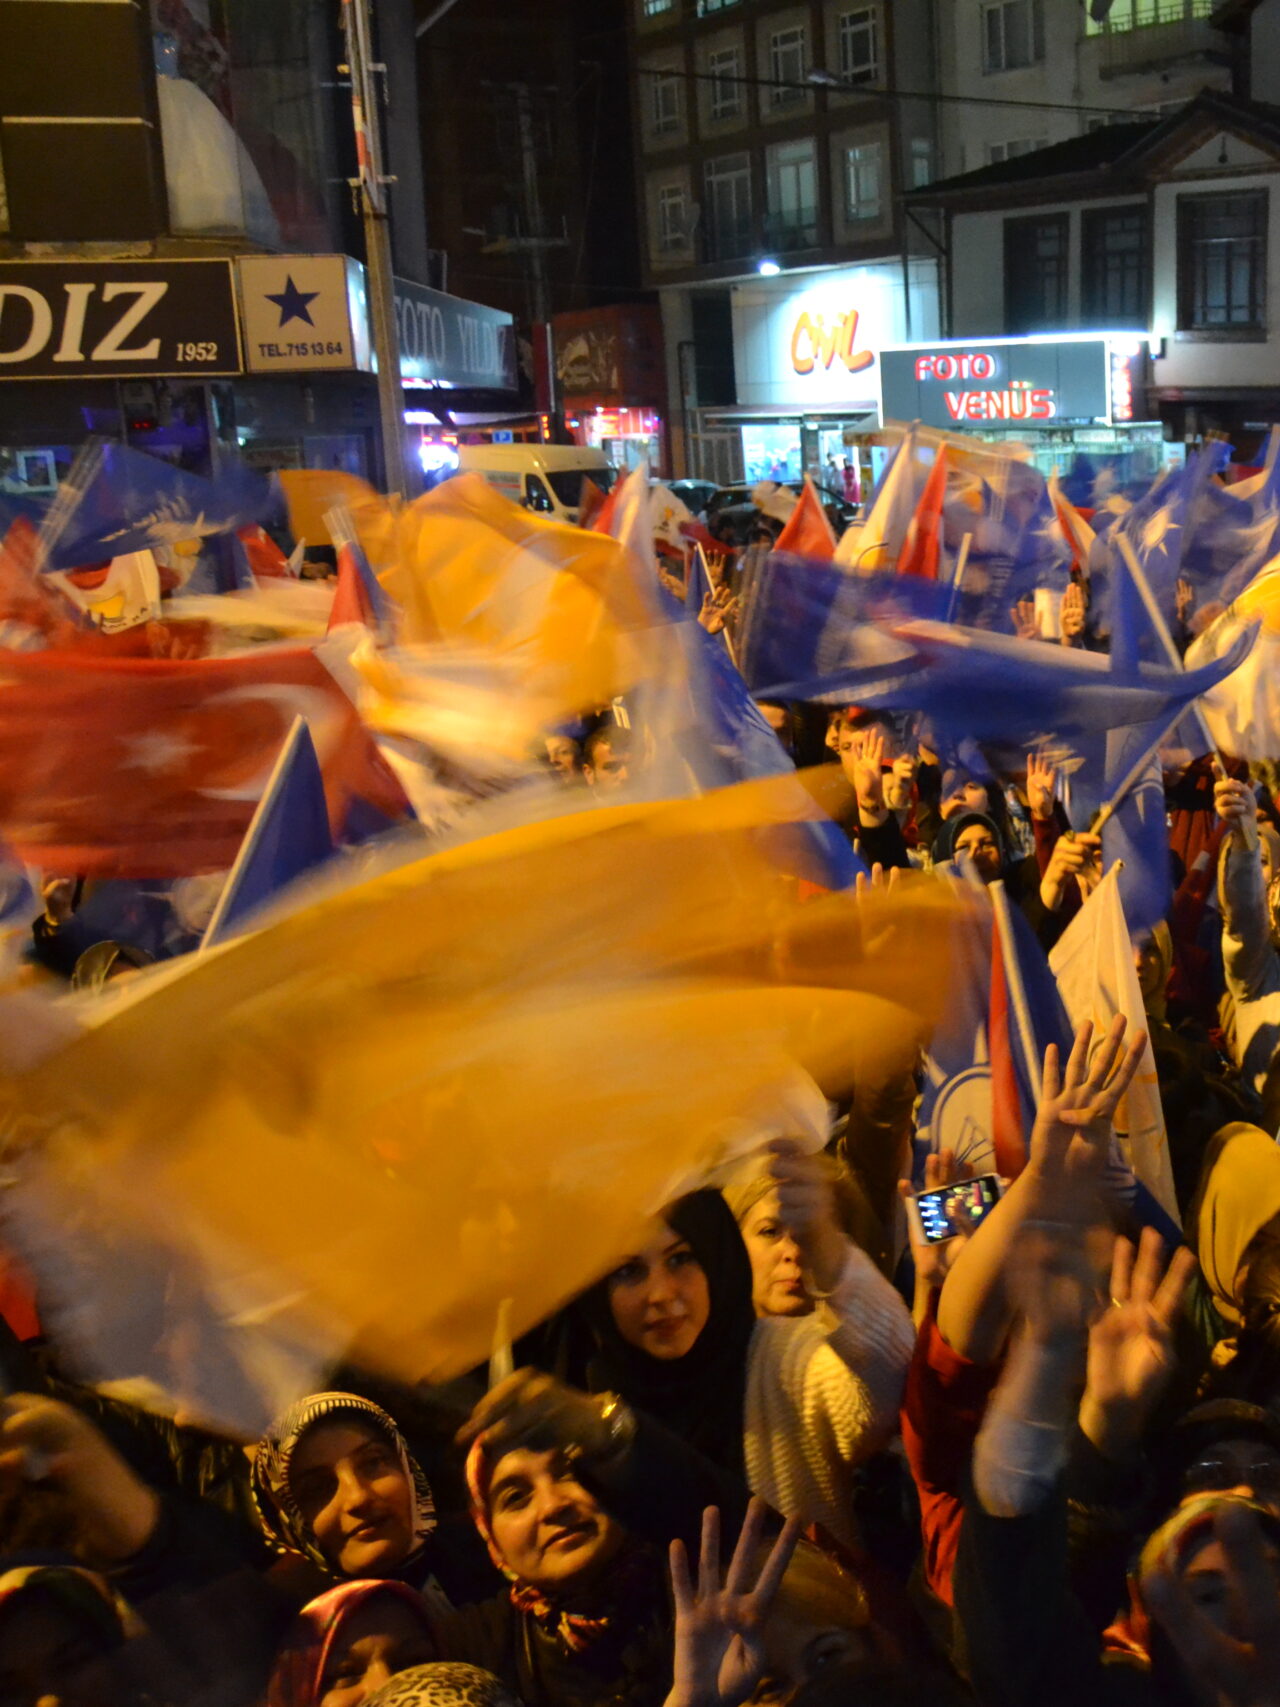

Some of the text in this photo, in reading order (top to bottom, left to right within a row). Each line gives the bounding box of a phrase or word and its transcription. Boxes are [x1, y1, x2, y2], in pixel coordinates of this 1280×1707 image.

[176, 342, 218, 362] 1952
[311, 342, 324, 356] 13
[326, 341, 343, 355] 64
[914, 353, 995, 381] FOTO
[943, 380, 1056, 420] VENÜS
